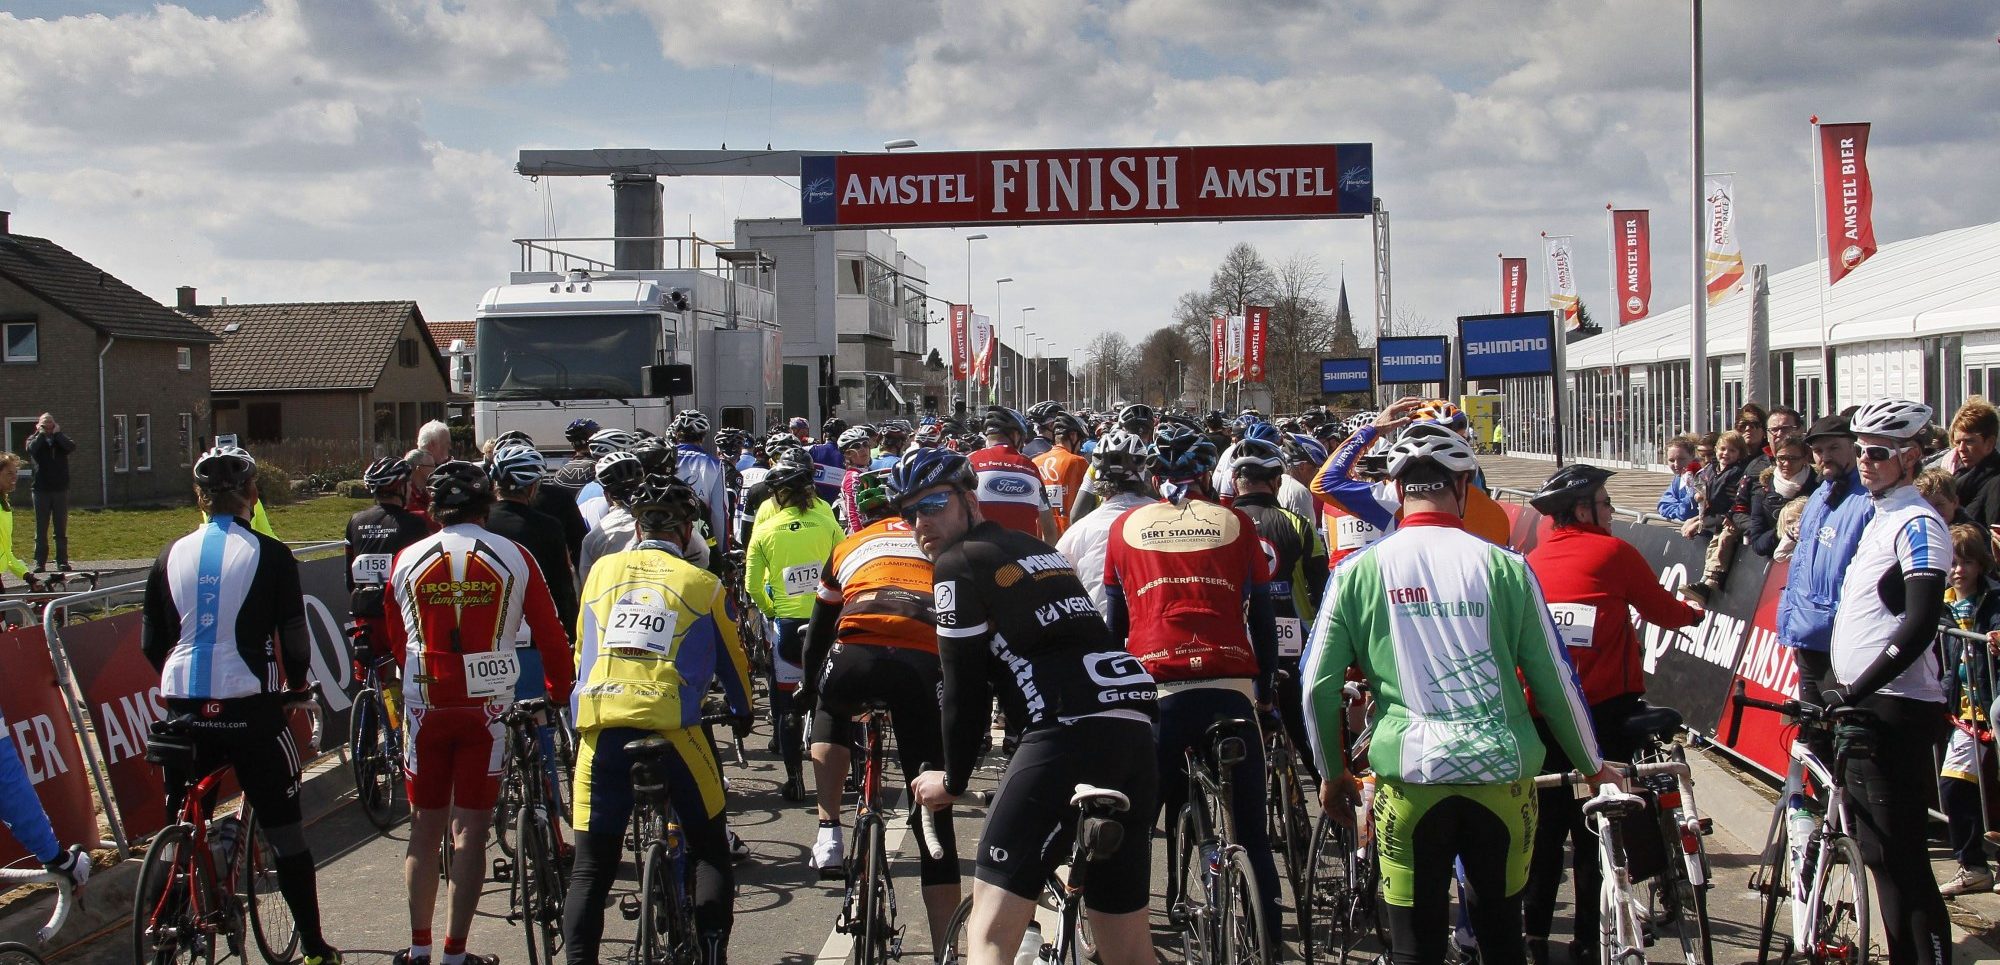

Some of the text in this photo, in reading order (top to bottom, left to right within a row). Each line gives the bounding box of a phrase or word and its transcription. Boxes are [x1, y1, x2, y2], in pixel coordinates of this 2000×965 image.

[841, 173, 975, 205] AMSTEL
[991, 156, 1180, 213] FINISH
[1199, 166, 1333, 198] AMSTEL
[1841, 137, 1858, 240] AMSTEL BIER
[1626, 219, 1637, 246] BIER
[1714, 202, 1723, 245] AMSTEL
[1511, 265, 1519, 286] BIER
[1627, 248, 1638, 292] AMSTEL
[1252, 313, 1261, 361] AMSTEL BIER
[1466, 337, 1548, 356] SHIMANO
[1382, 354, 1443, 366] SHIMANO
[1323, 371, 1368, 380] SHIMANO
[927, 463, 944, 482] BBB
[996, 478, 1025, 493] Ford
[1405, 482, 1444, 492] GIRO
[1141, 528, 1221, 540] BERT STADMAN
[1342, 520, 1374, 534] 1183
[358, 559, 387, 571] 1158
[1017, 551, 1074, 574] MENNE
[199, 574, 220, 586] sky
[788, 567, 819, 583] 4173
[426, 580, 497, 593] ROSSEM
[1388, 586, 1429, 605] TEAM
[614, 611, 666, 633] 2740
[1553, 610, 1575, 627] 50
[1276, 624, 1294, 639] 96
[467, 658, 516, 679] 10031
[1736, 625, 1801, 701] AMSTE
[206, 703, 220, 714] IG
[101, 683, 169, 764] AMS
[192, 720, 248, 729] markets.com
[12, 713, 69, 786] ER
